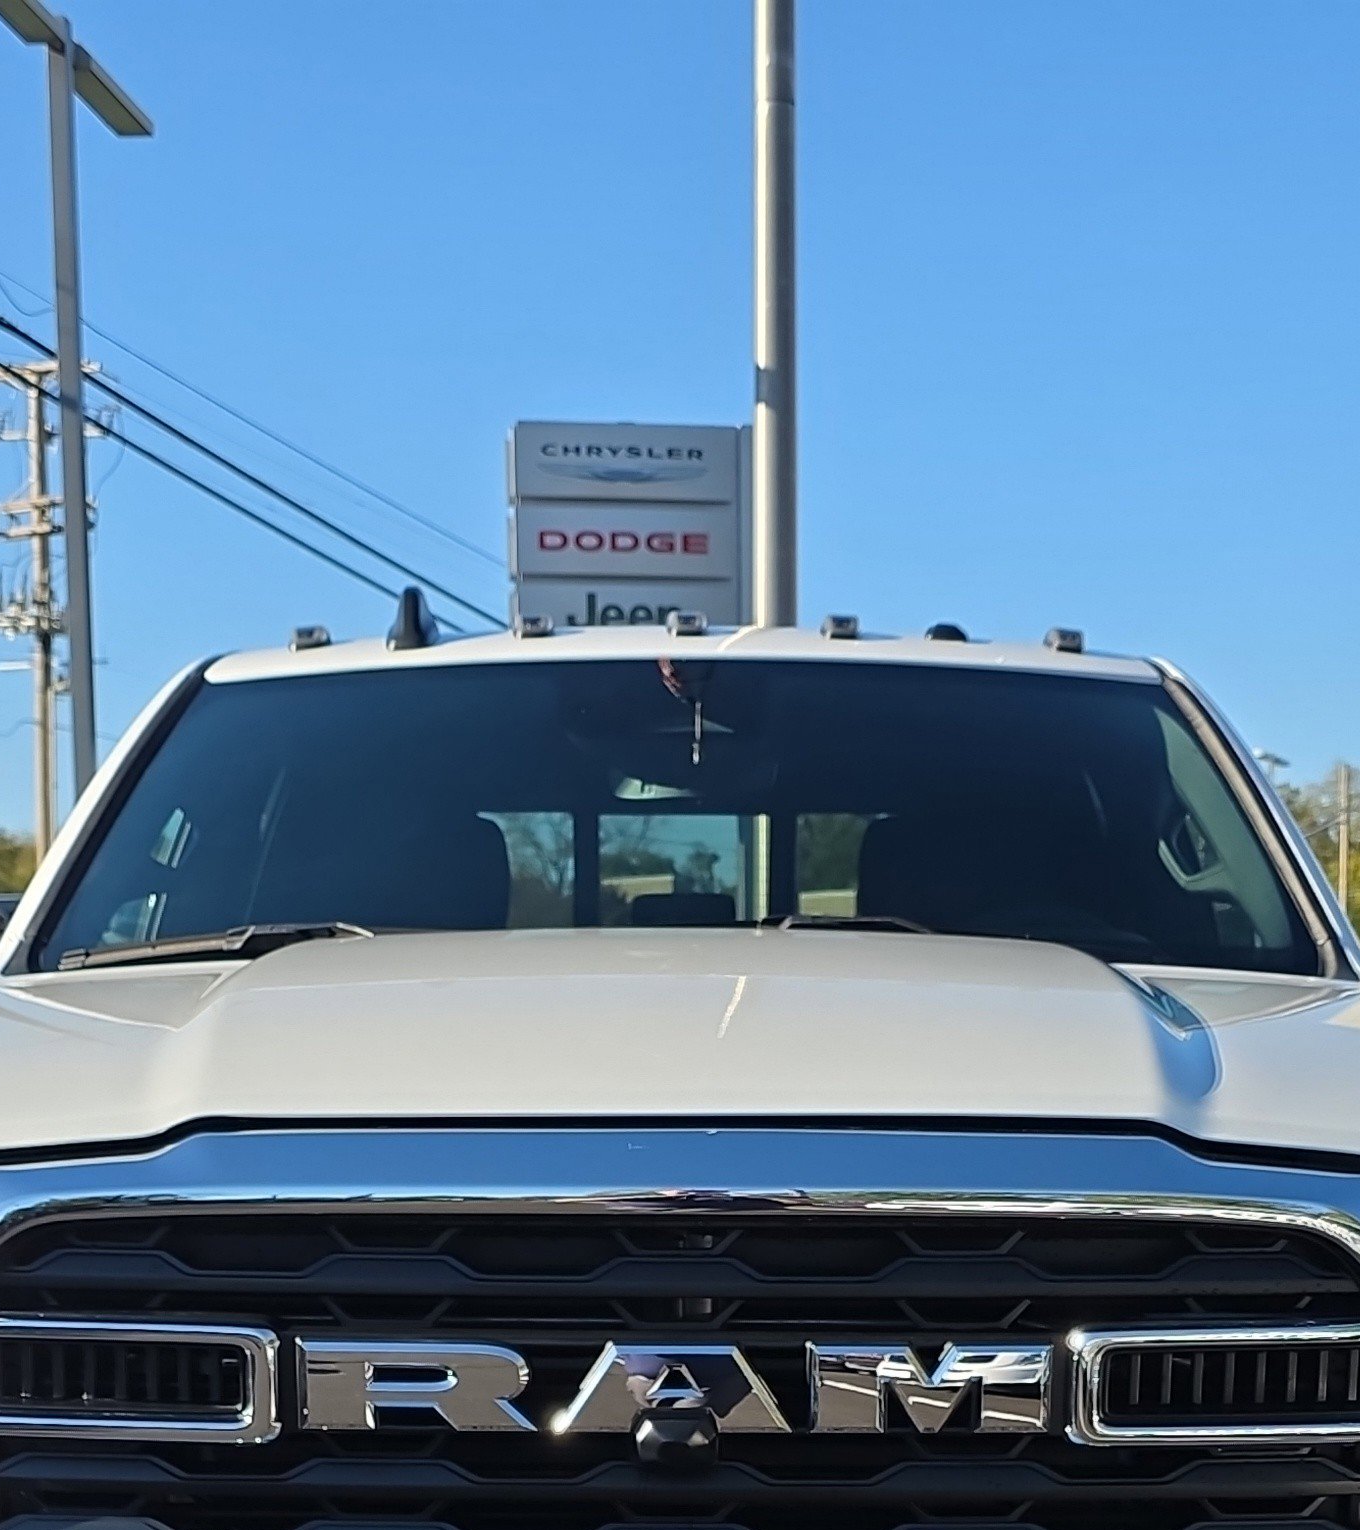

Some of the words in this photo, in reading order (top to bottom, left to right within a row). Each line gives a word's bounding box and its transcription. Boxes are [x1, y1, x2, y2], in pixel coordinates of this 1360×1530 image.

[541, 443, 704, 461] CHRYSLER
[539, 530, 709, 554] DODGE
[295, 1338, 1052, 1434] RAM
